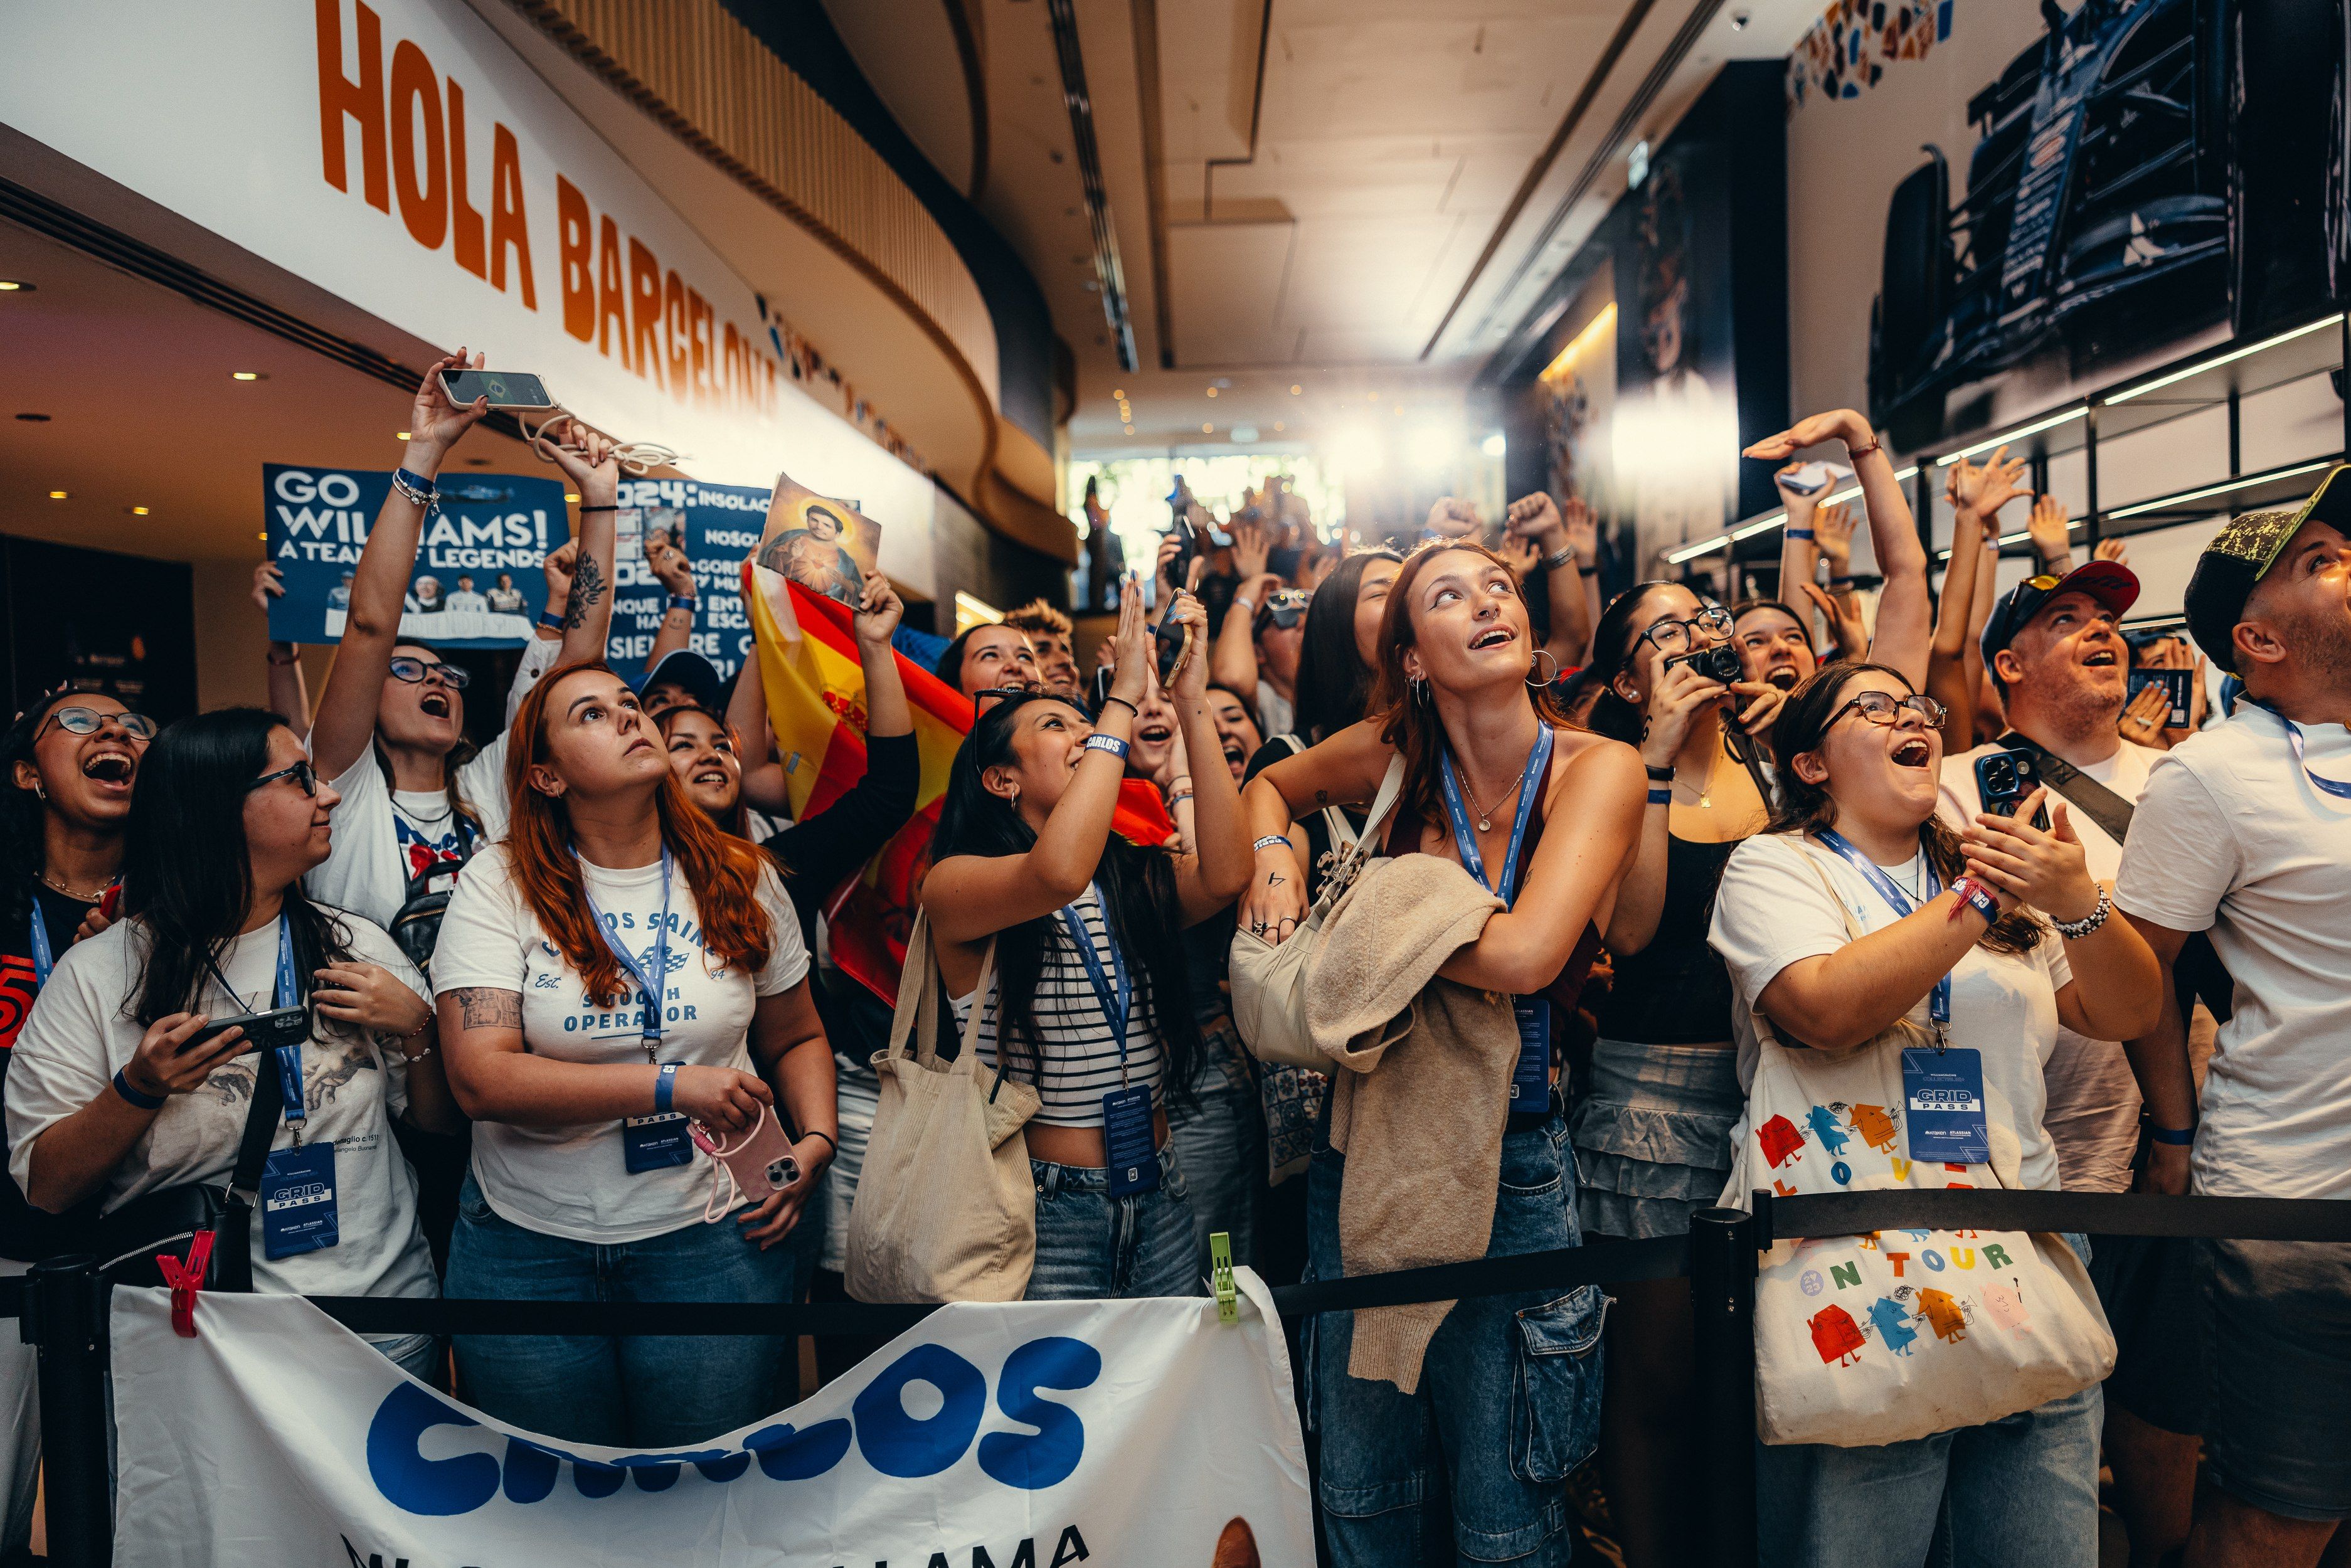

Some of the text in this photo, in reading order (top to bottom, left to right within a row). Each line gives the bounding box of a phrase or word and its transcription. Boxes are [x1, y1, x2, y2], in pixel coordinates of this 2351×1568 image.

[315, 0, 779, 416] HOLA BARCELONA
[274, 470, 360, 507] GO
[616, 480, 698, 509] 024:
[275, 505, 549, 549] WILAMS!
[278, 539, 298, 559] A
[428, 547, 547, 569] LEGENDS
[1086, 736, 1122, 753] CARLOS
[1951, 879, 1990, 909] CAOS
[535, 973, 562, 989] Est.
[564, 1005, 698, 1032] OPERAOR
[1918, 1089, 1972, 1103] GRID
[637, 1113, 677, 1125] PASS
[274, 1182, 324, 1202] GRID
[279, 1195, 321, 1209] PASS
[1886, 1243, 2014, 1278] TOUR
[367, 1336, 1101, 1516] COS
